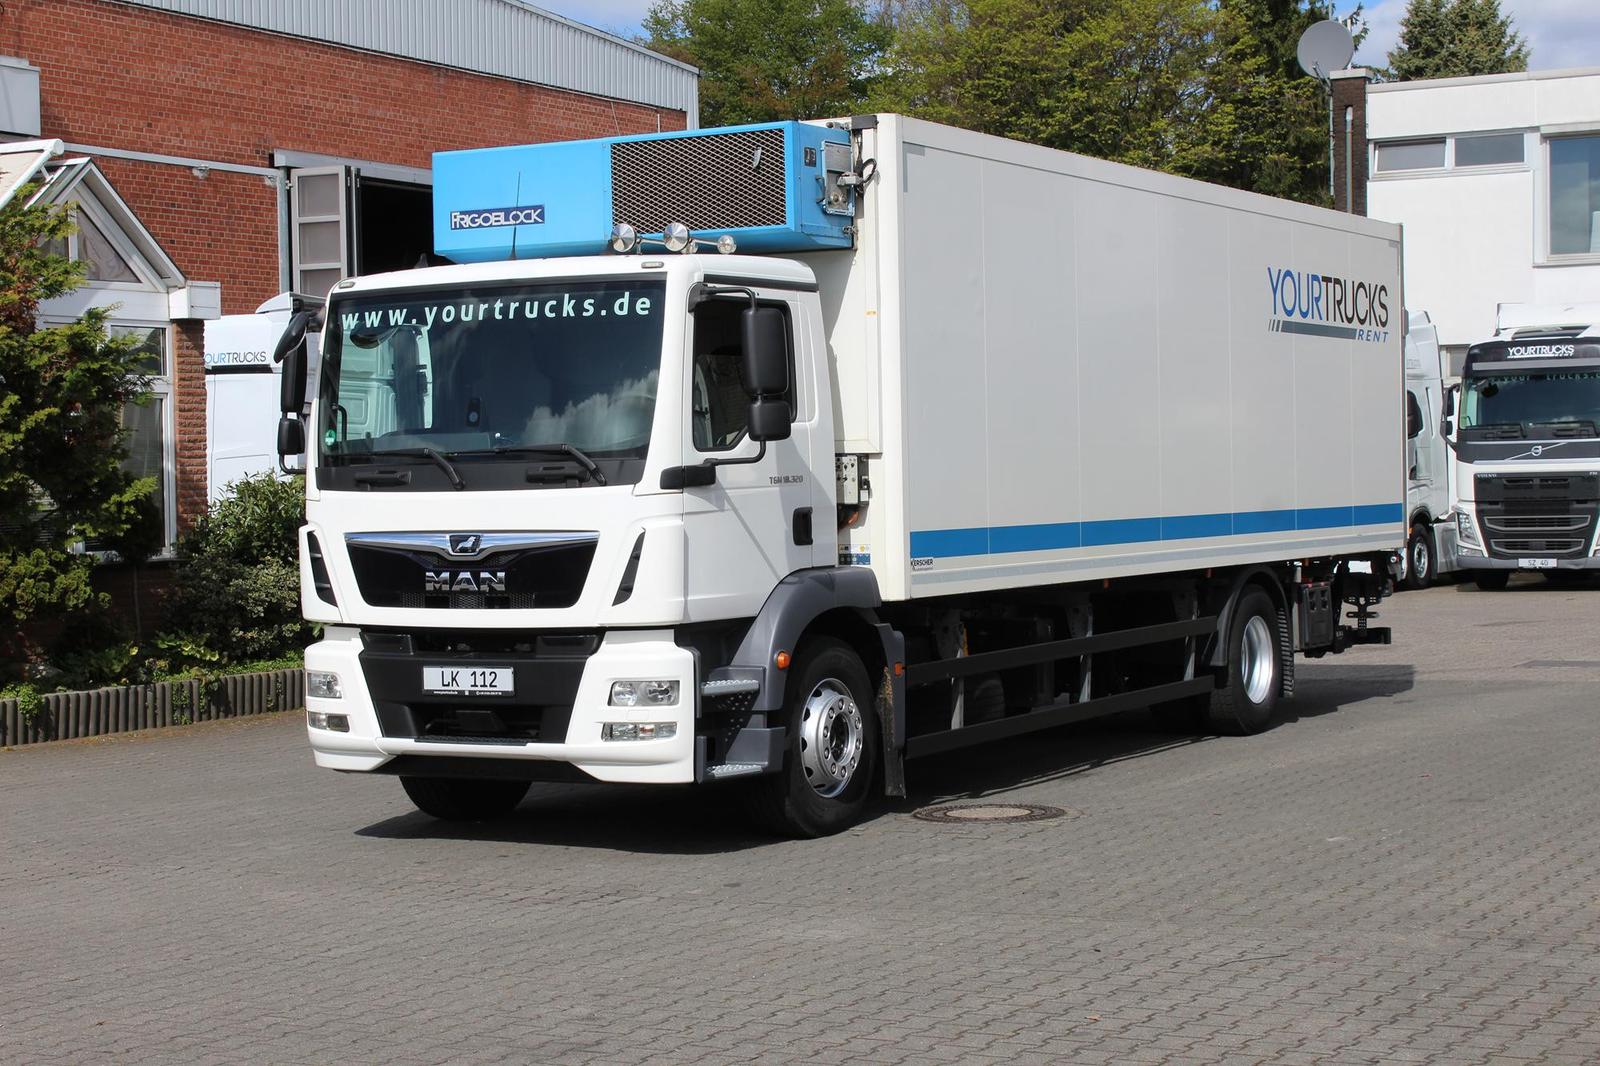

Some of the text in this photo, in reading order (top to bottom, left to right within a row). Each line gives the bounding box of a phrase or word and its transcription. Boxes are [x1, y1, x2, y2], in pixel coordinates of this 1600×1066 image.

[1267, 266, 1389, 328] YOURTRUCKS
[341, 291, 651, 330] www.yourtrucks.de
[1357, 329, 1389, 343] RENT
[204, 351, 267, 364] OURTRUCKS
[1507, 345, 1575, 356] YOURTRUCKS
[425, 571, 506, 592] MAN
[441, 670, 498, 688] LK 112
